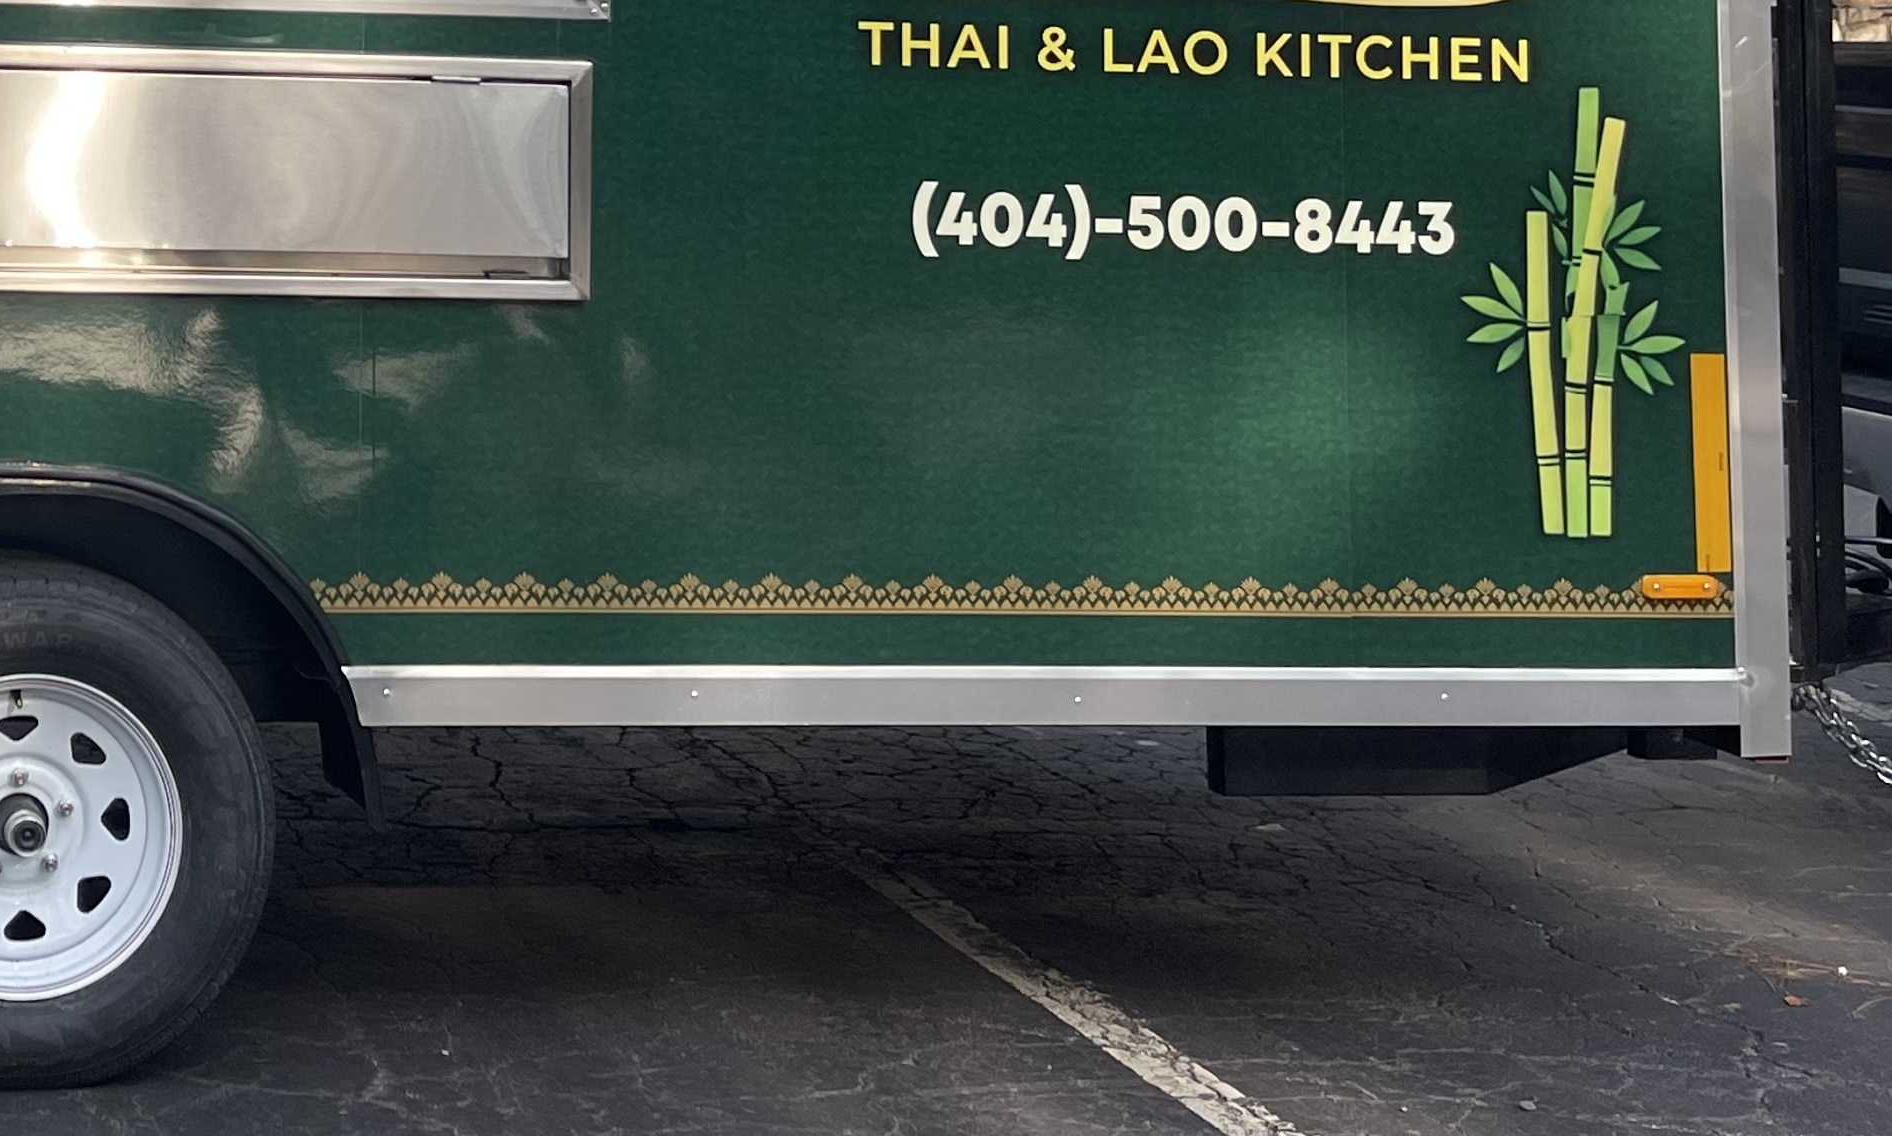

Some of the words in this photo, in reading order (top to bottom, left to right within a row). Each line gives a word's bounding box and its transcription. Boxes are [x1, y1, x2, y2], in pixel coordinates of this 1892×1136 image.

[857, 20, 1010, 71] THAI
[1036, 25, 1077, 72] &
[1102, 27, 1229, 76] LAO
[1255, 31, 1530, 84] KITCHEN
[911, 179, 1456, 261] (404)-500-8443
